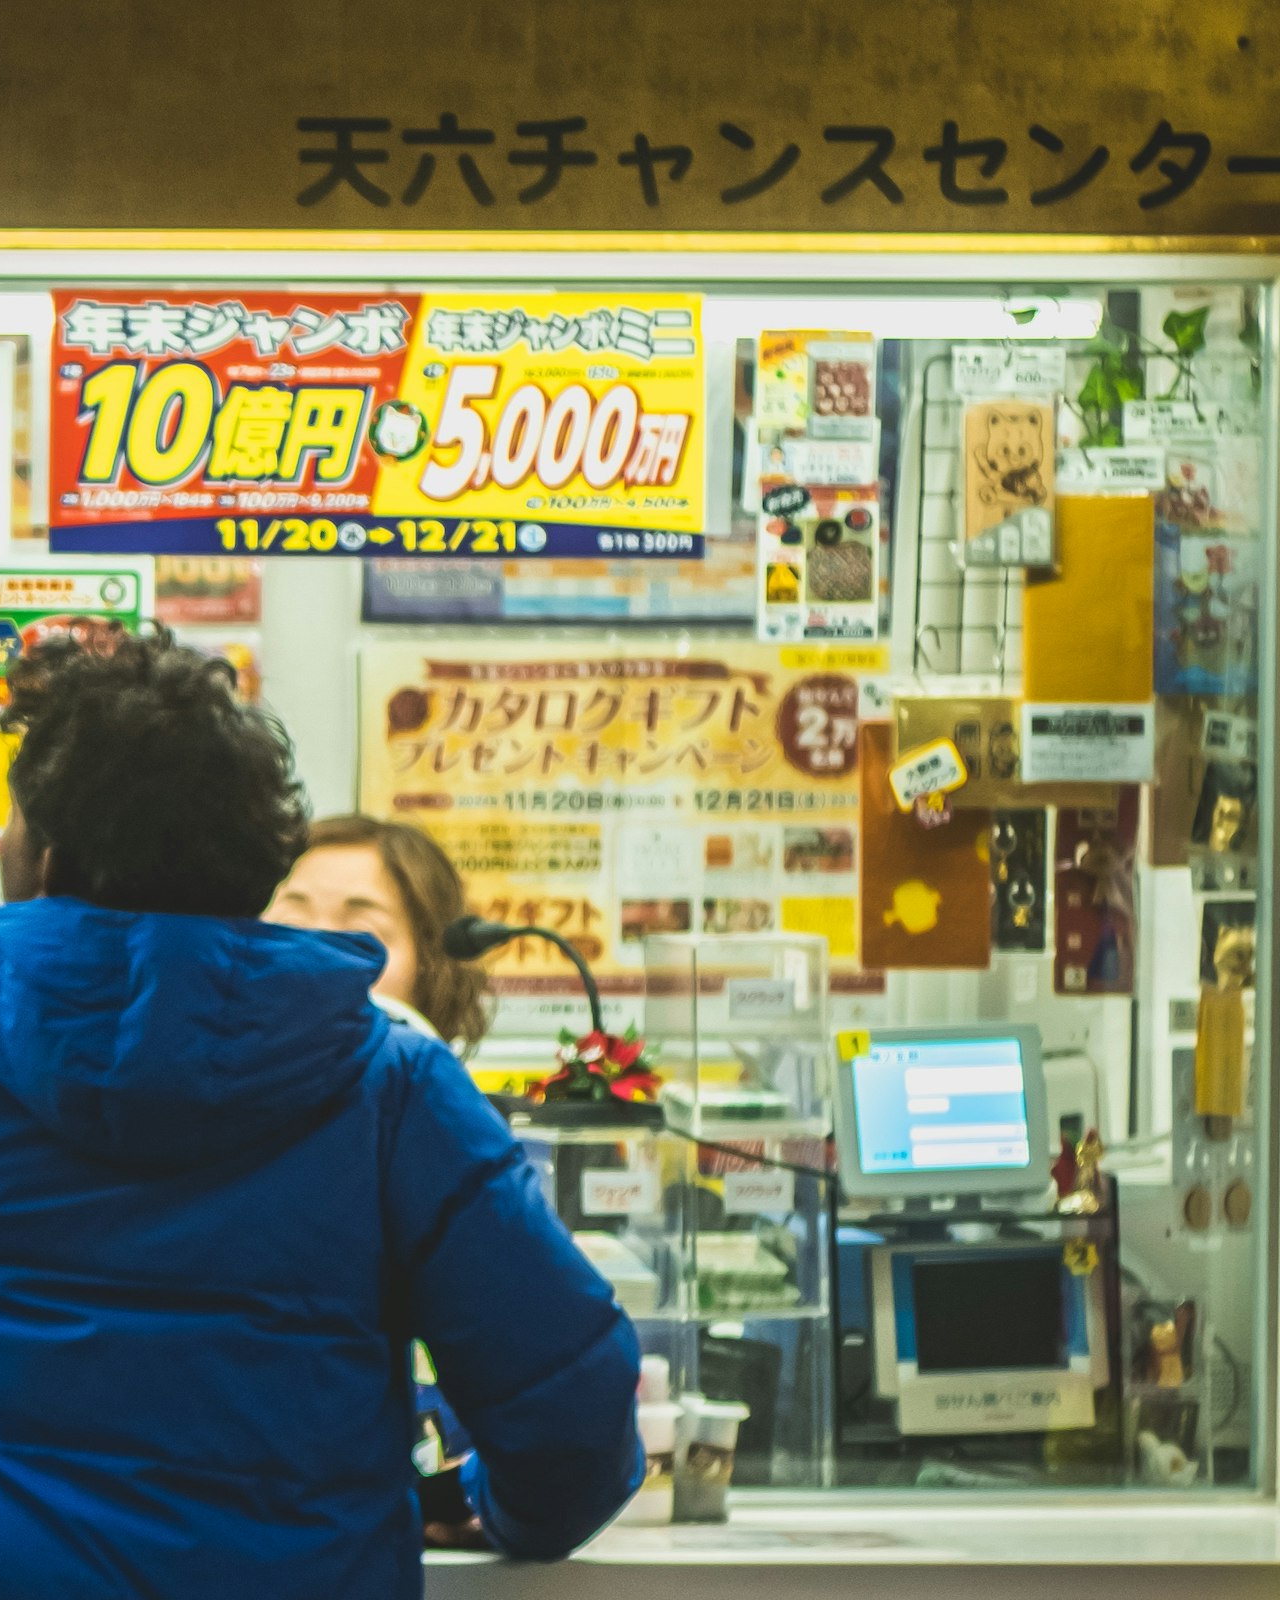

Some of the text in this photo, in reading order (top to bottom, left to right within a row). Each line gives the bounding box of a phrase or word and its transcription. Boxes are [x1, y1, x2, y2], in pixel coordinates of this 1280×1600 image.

[296, 112, 1280, 208] 天六チャンスセンター
[63, 300, 412, 357] 年末ジャンボ
[427, 305, 696, 361] 年末ジャンボミニ
[78, 359, 374, 488] 10億円
[419, 361, 694, 502] 5,000万円
[220, 519, 335, 552] 11/20
[400, 518, 518, 552] 12/21
[444, 686, 764, 734] カタログギフト
[391, 738, 775, 775] プレゼントキャンペーン
